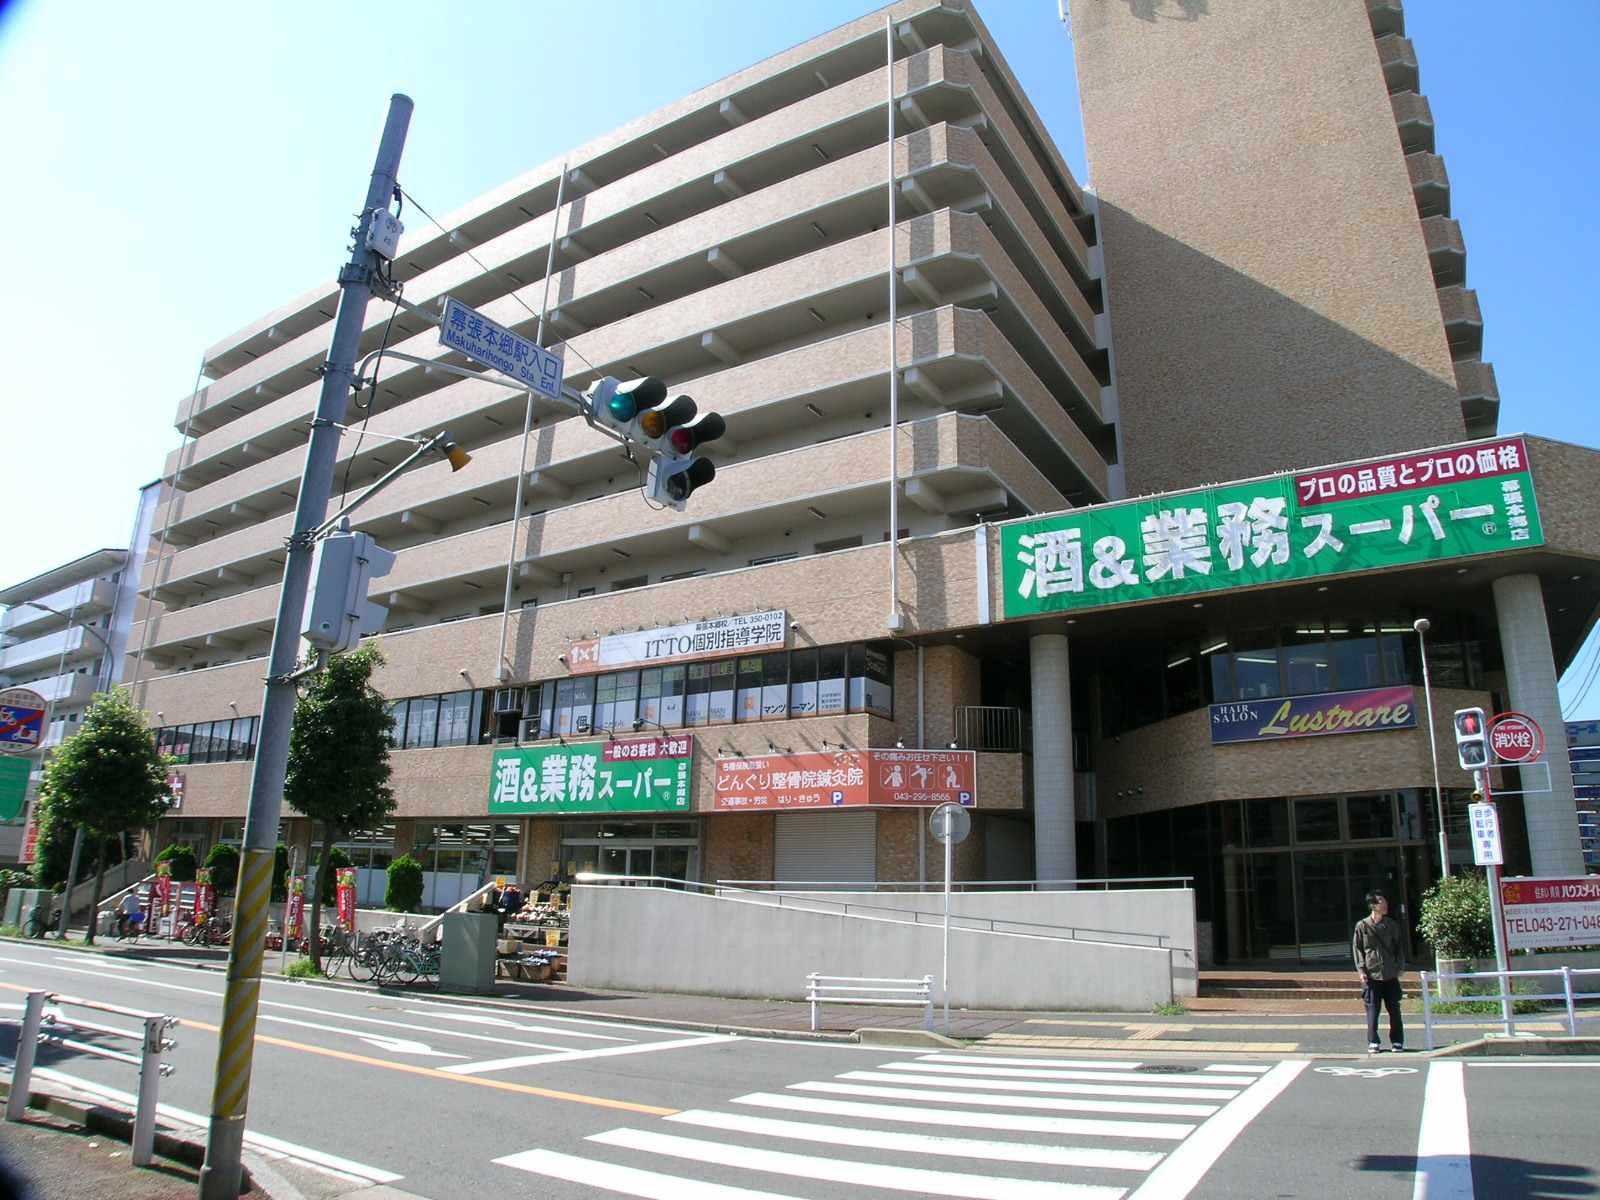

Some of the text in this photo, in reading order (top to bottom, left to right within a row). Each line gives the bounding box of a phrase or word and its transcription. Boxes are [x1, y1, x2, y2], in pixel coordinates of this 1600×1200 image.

[450, 307, 558, 380] 幕張本郷駅入口
[446, 329, 556, 394] Makuharihongo Sta. Ent.
[1299, 445, 1521, 501] プロの品質とプロの価格
[1500, 479, 1530, 541] 幕張本郷店
[1017, 494, 1495, 600] 酒&業務スーパー
[750, 612, 783, 624] 350-0102
[644, 622, 782, 658] ITTO個別指導学院
[1213, 711, 1258, 723] SALON
[1220, 704, 1249, 714] HAIR
[1258, 701, 1411, 736] Lustrare
[605, 740, 687, 759] 一般のお客様 大歓迎
[1494, 732, 1531, 749] 消火栓
[493, 753, 671, 803] 酒&業務スーパー
[717, 768, 864, 791] どんぐり整骨院鍼灸院
[894, 792, 950, 801] 043-296-8566
